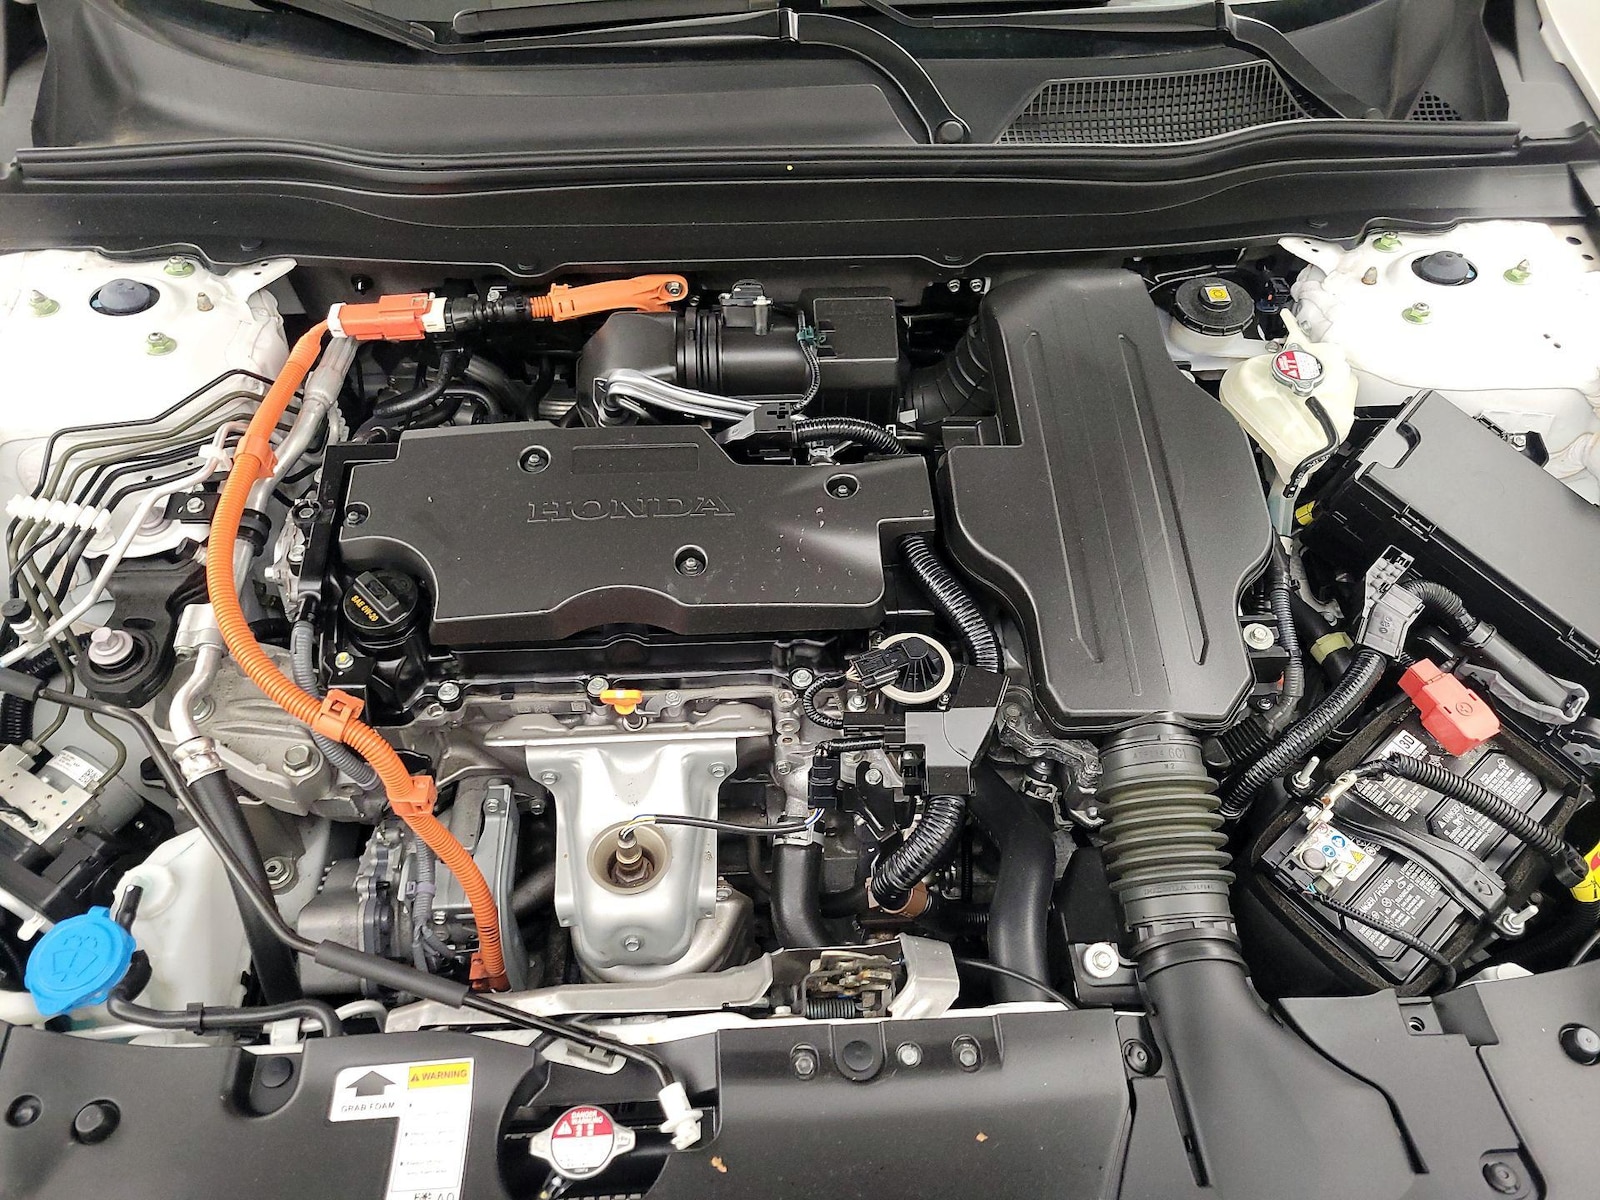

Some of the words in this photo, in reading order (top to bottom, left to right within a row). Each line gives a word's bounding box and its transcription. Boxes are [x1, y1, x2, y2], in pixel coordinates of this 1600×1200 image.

[527, 496, 736, 523] HONDA
[351, 595, 365, 607] SAE
[422, 1069, 468, 1081] WARNING
[341, 1104, 367, 1113] GRAB
[369, 1101, 395, 1109] FOAM
